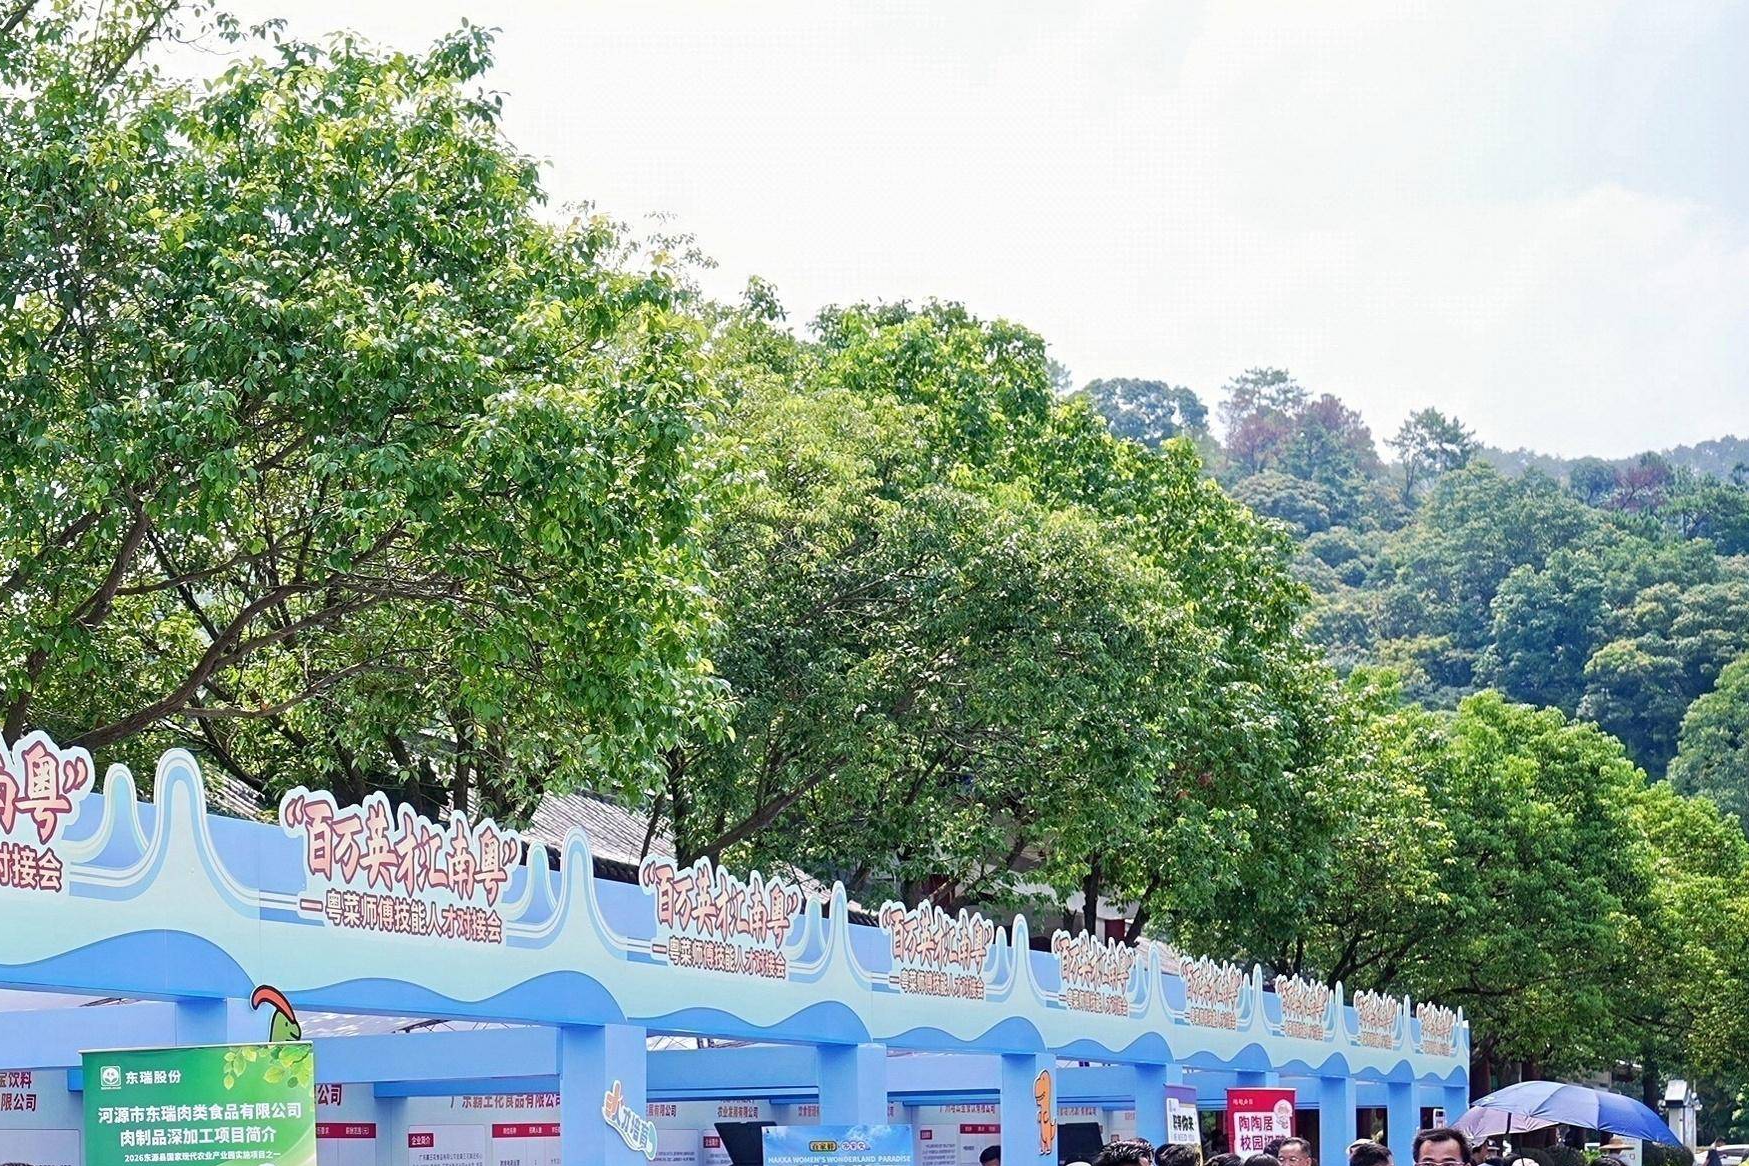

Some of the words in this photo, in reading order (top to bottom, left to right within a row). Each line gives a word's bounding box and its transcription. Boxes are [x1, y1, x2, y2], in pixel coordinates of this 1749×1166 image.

[285, 795, 517, 904] “百万英才汇南粤”
[643, 860, 798, 948] “百万英才汇南粤”
[125, 1070, 181, 1084] 东瑞股份
[98, 1102, 302, 1124] 河源市东瑞肉类食品有限公司
[1238, 1116, 1273, 1131] 陶陶居
[120, 1126, 277, 1147] 肉制品深加工项目简介
